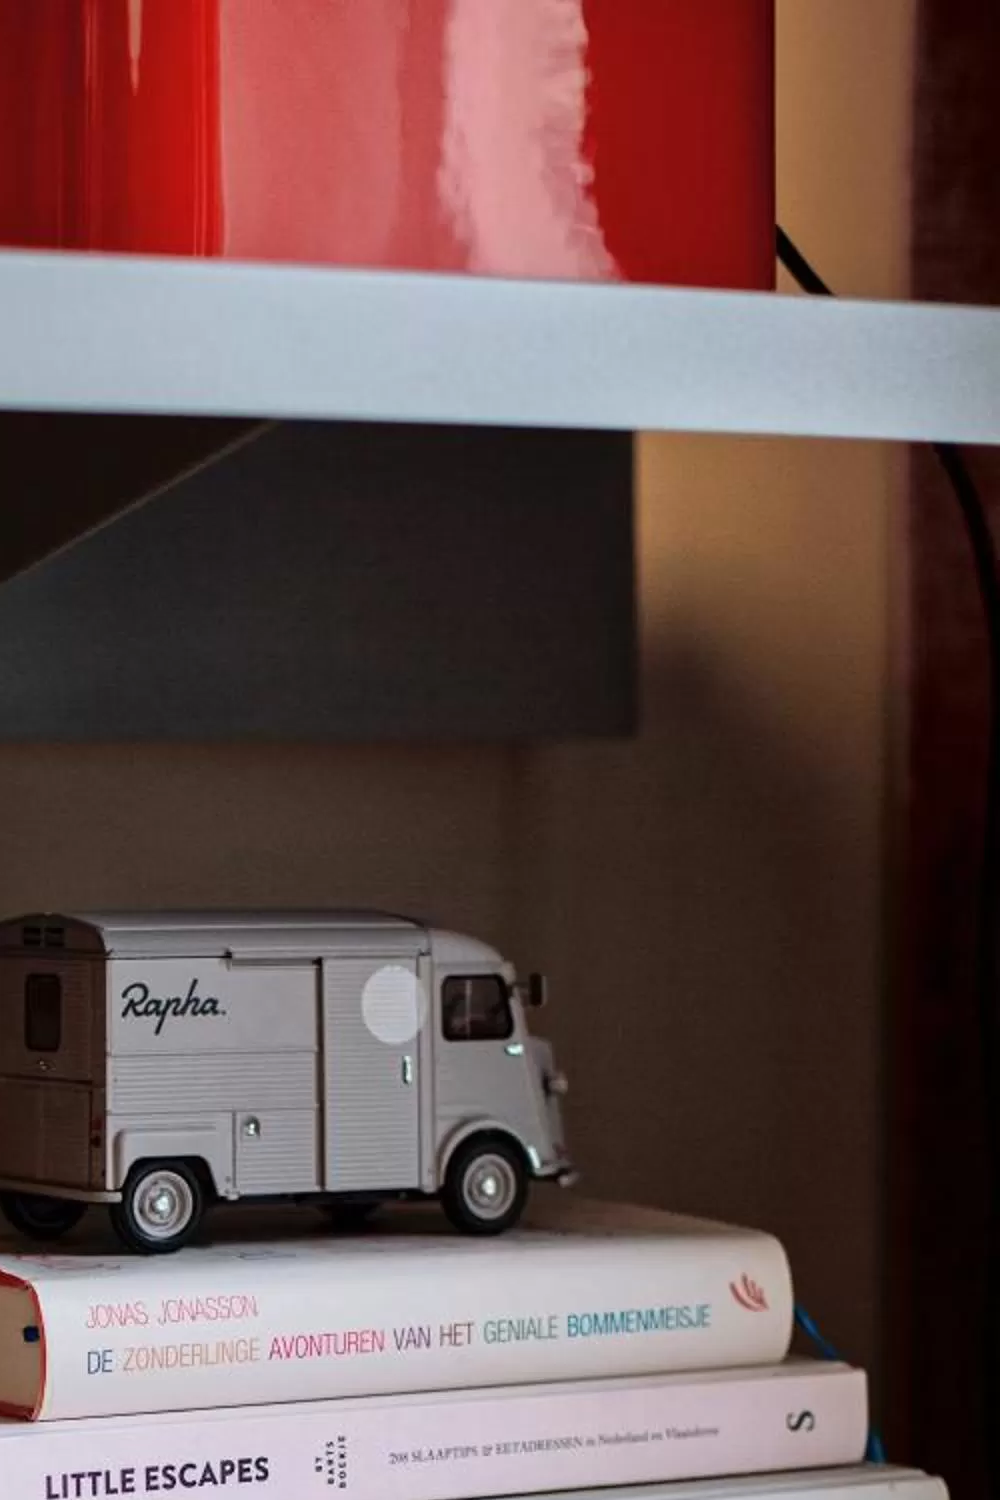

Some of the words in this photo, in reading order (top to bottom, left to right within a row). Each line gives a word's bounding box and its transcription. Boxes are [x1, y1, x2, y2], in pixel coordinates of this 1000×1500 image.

[86, 1301, 149, 1329] JONAS
[157, 1294, 260, 1326] JONASSON
[86, 1349, 113, 1374] DE
[122, 1337, 260, 1372] ZONDERLINGE
[268, 1329, 385, 1361] AVONTUREN
[392, 1325, 432, 1351] VAN
[438, 1321, 475, 1347] HET
[483, 1315, 559, 1345] GENIALE
[566, 1304, 711, 1338] BOMMENMEISJE
[45, 1467, 135, 1500] LITTLE
[145, 1456, 270, 1492] ESCAPES
